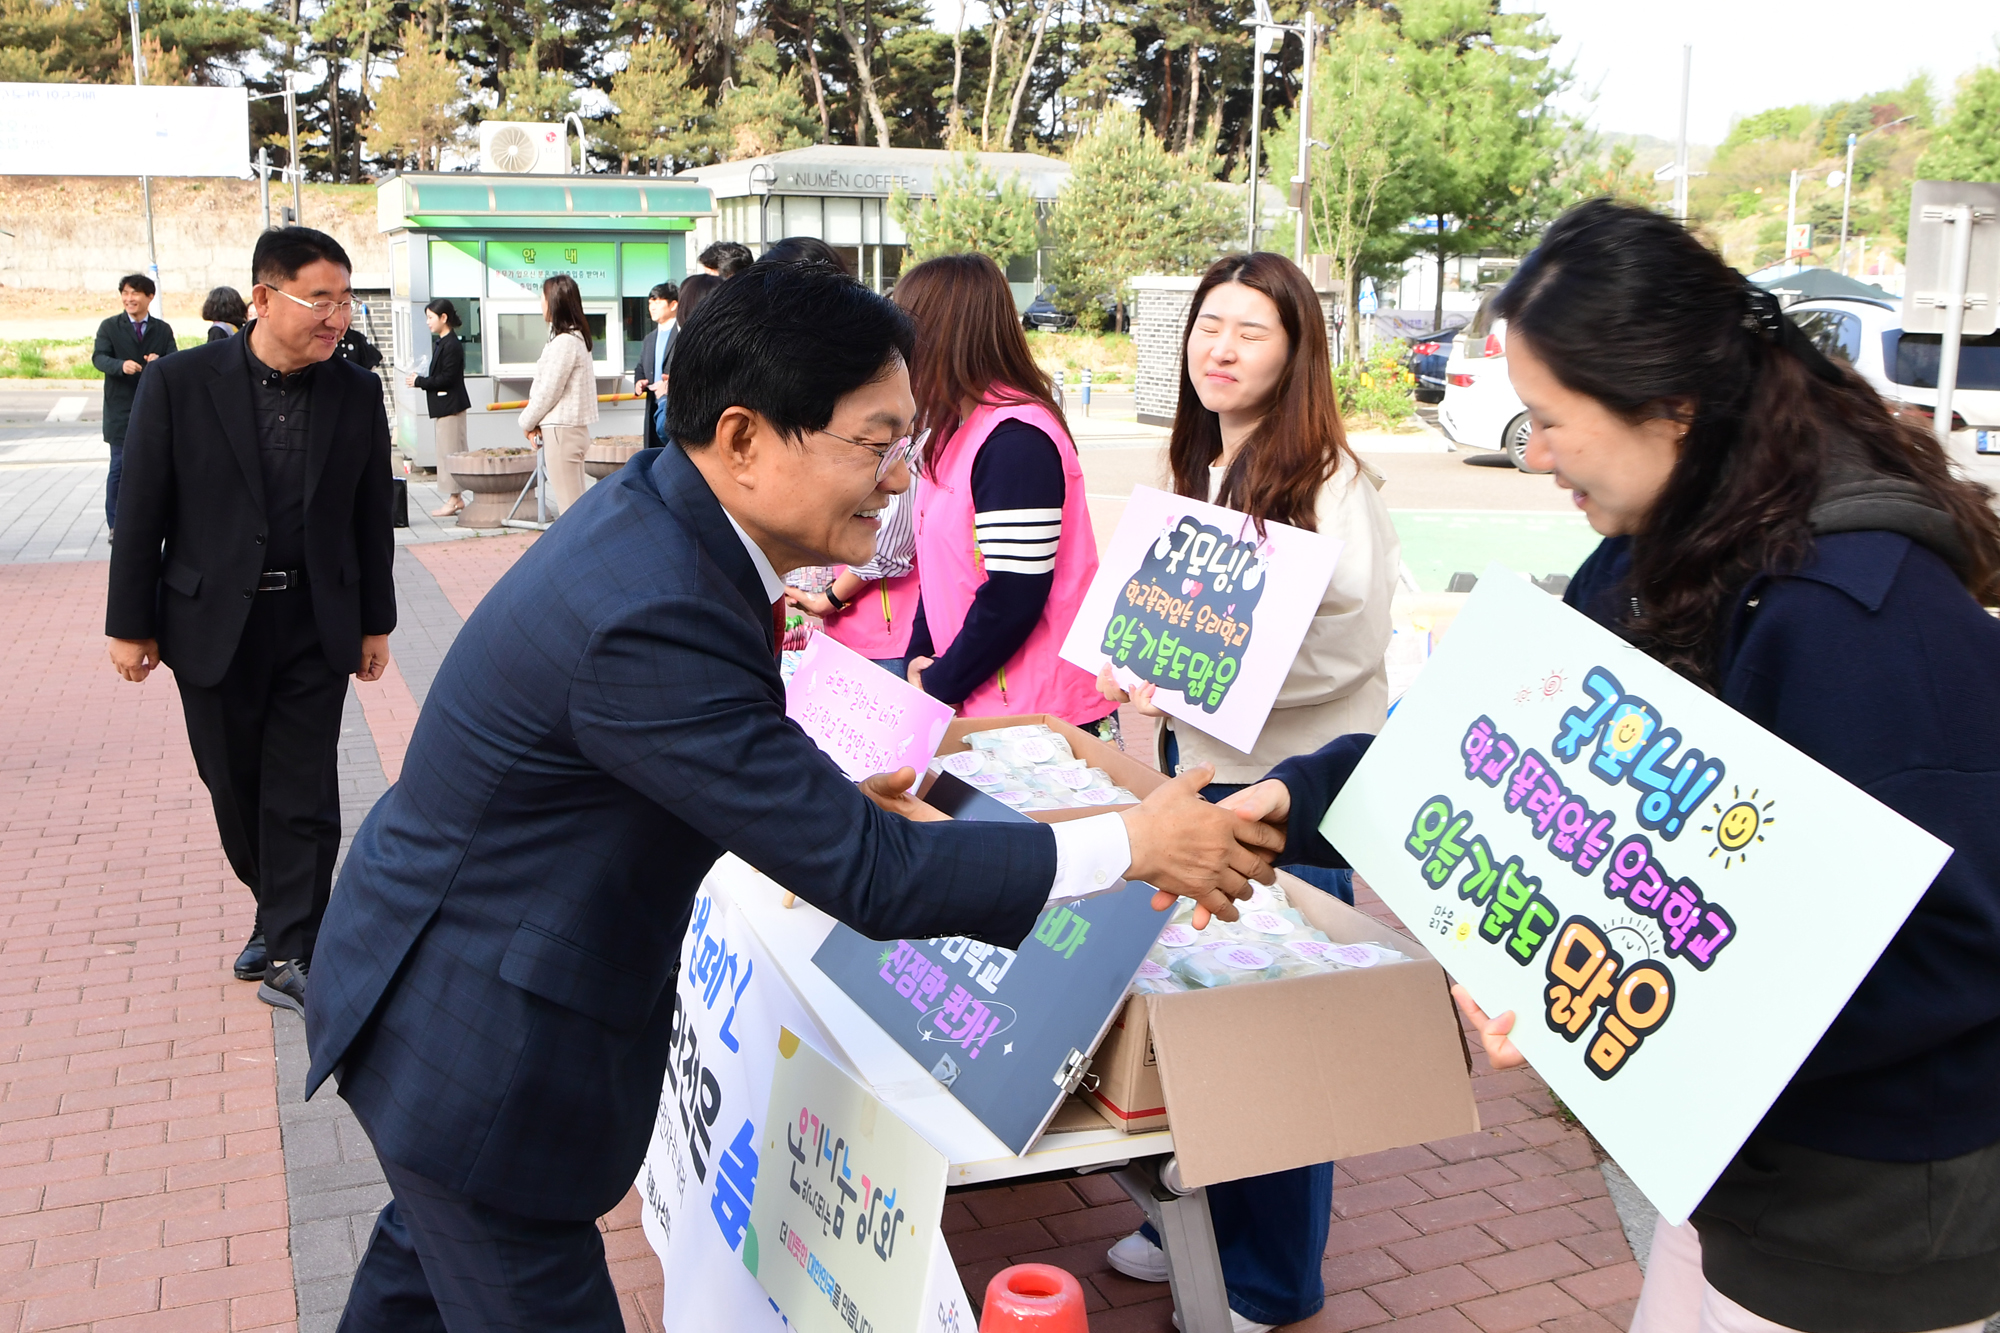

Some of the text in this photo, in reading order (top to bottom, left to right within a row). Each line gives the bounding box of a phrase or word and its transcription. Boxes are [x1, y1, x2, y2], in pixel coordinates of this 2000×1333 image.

[854, 174, 909, 189] COFFEE
[1196, 605, 1249, 647] 우리학교
[850, 683, 879, 719] 말하는
[878, 705, 905, 730] 네가
[838, 723, 866, 760] 진정한
[1603, 835, 1735, 969] 우리학교
[1034, 906, 1091, 959] 네가
[929, 936, 1018, 994] 리학교
[878, 939, 1000, 1059] 진정한 퀸카!
[1545, 916, 1674, 1079] 맑음
[788, 1107, 857, 1240] 온기나눔
[779, 1220, 788, 1245] 더
[787, 1229, 808, 1268] 따뜻한
[807, 1252, 841, 1310] 대한민국을
